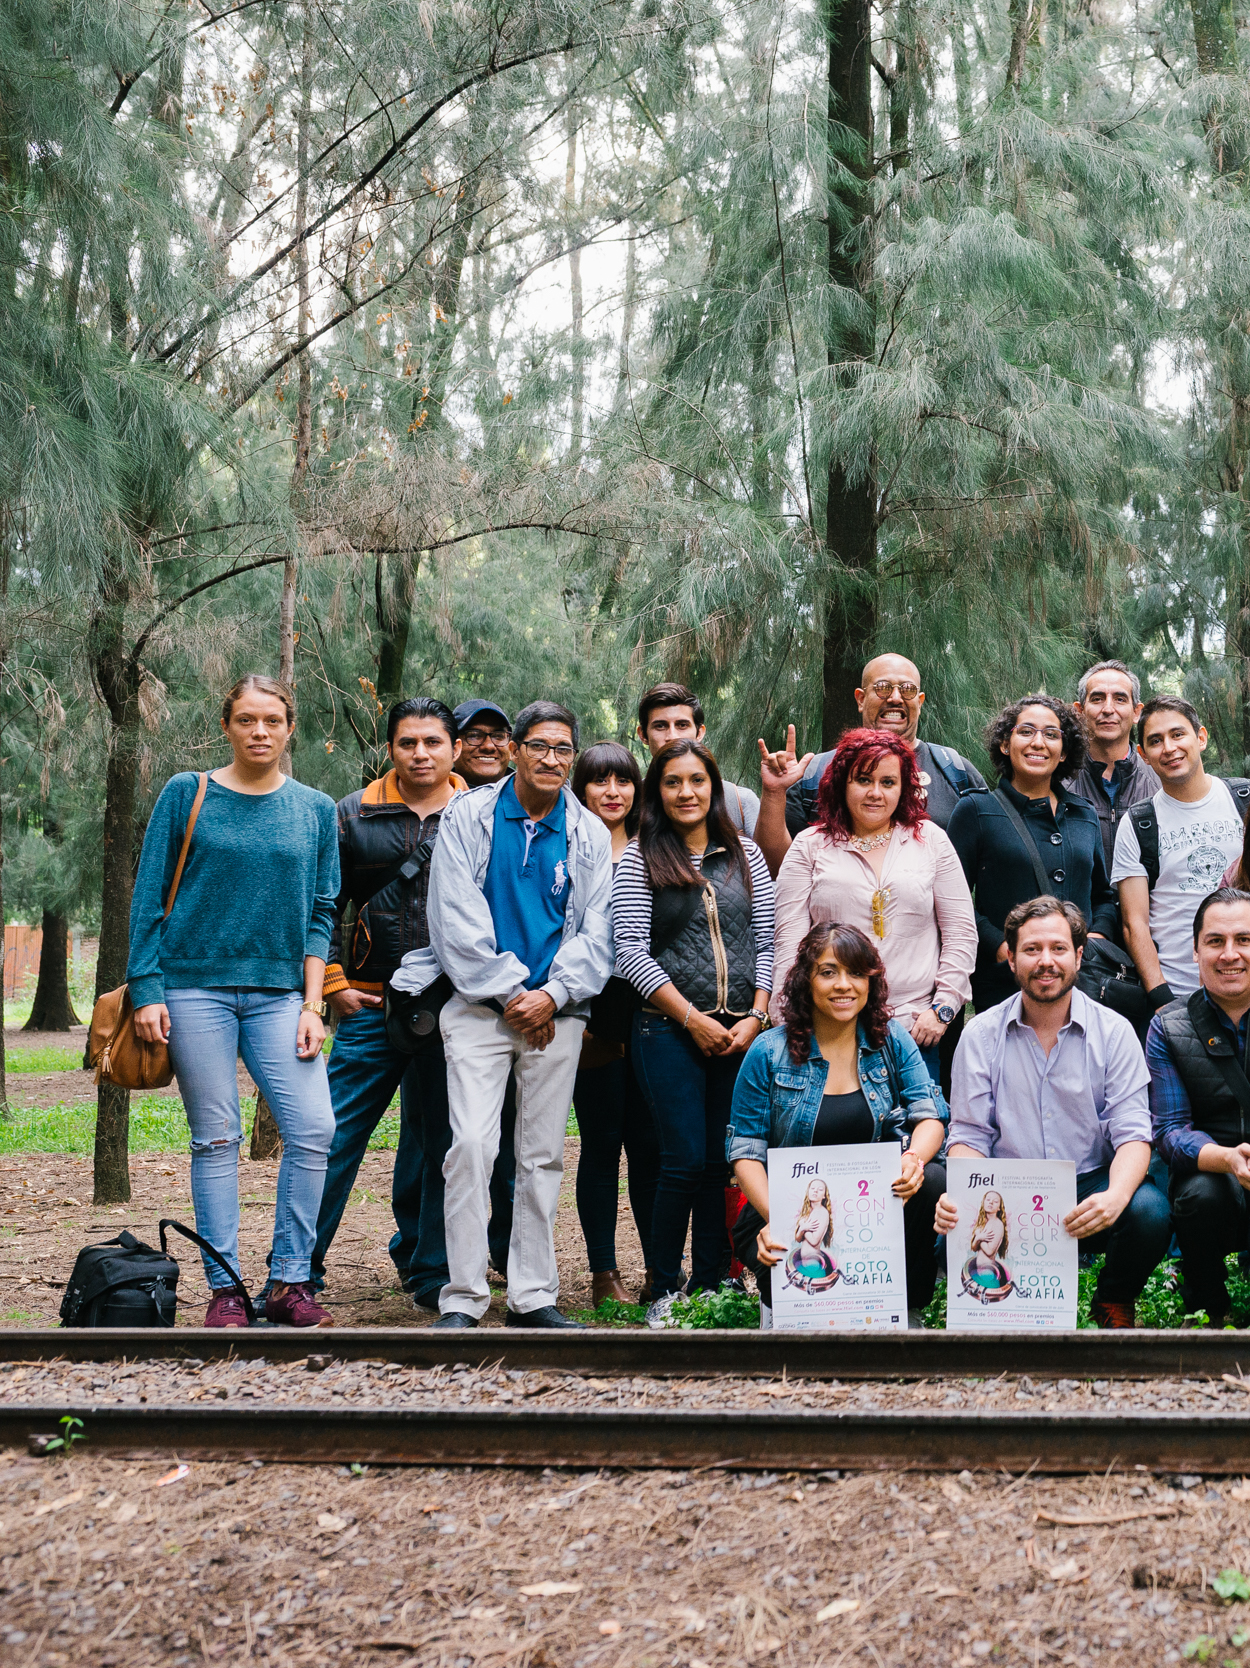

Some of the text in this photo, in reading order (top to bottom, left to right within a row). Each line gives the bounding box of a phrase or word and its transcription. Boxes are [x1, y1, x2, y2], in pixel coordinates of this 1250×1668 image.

[1173, 837, 1206, 851] SINCE
[791, 1162, 819, 1178] ffiel
[968, 1173, 994, 1188] ffiel
[843, 1198, 885, 1212] CON
[844, 1212, 884, 1227] CUR
[1018, 1213, 1059, 1227] CON
[846, 1228, 873, 1243] SO
[1019, 1227, 1058, 1241] CUR
[1020, 1242, 1047, 1256] SO
[846, 1260, 888, 1273] FOTO
[1020, 1275, 1060, 1287] FOTO
